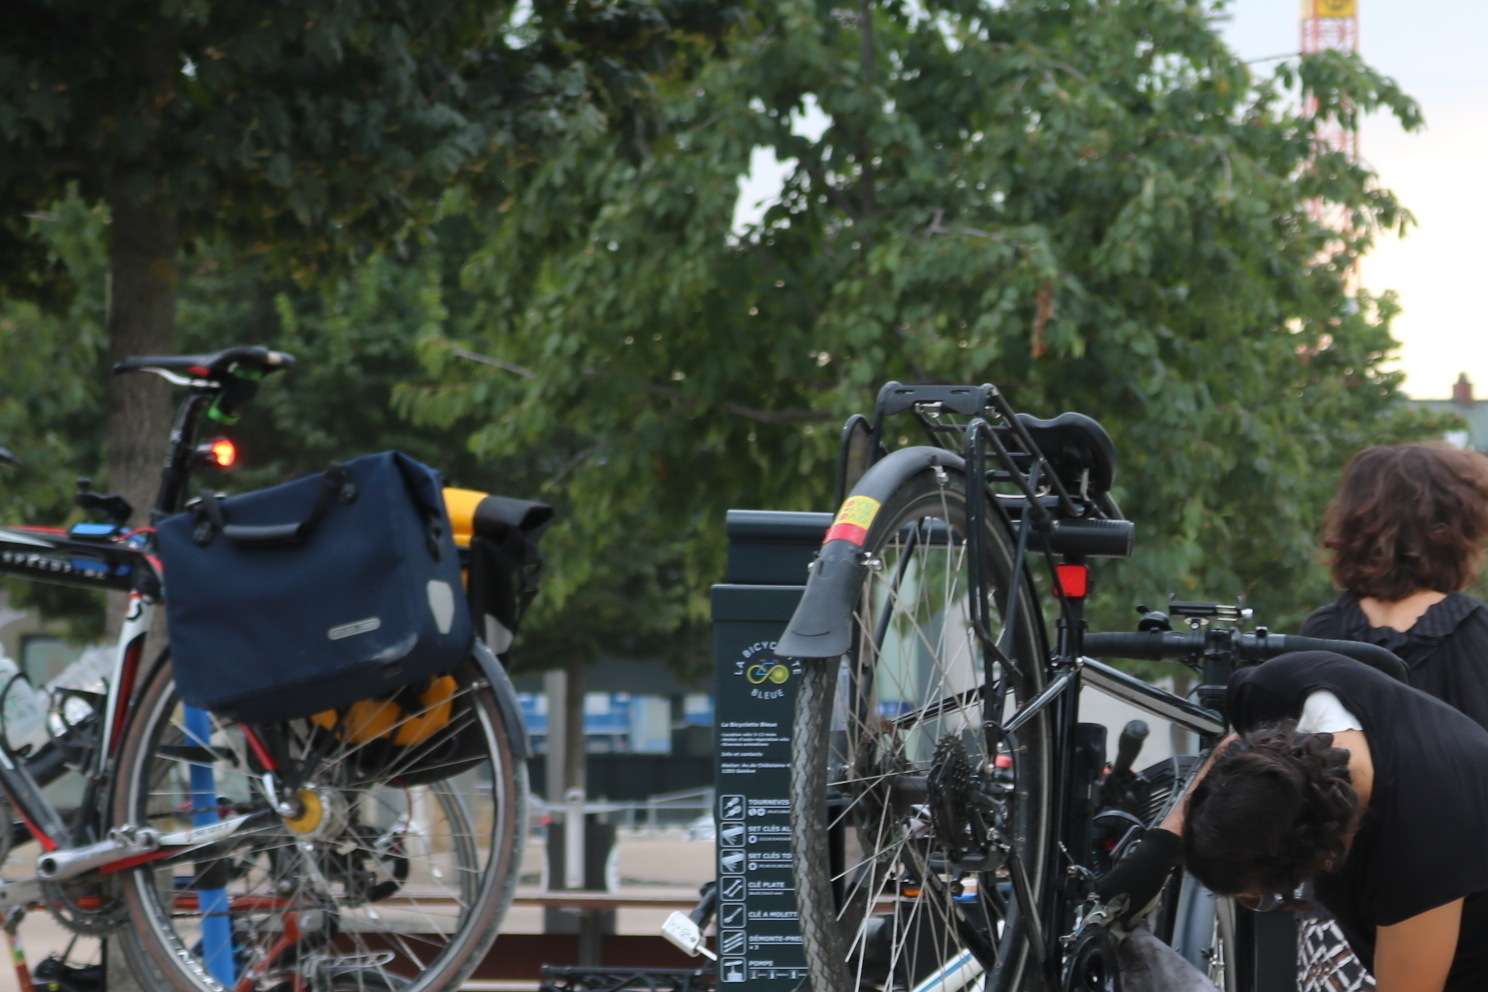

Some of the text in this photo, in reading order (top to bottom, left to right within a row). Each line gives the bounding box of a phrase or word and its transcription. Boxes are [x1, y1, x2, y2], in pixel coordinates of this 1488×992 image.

[734, 661, 746, 676] LA
[751, 688, 785, 700] BLEUE
[762, 824, 781, 832] CLÉS
[762, 851, 781, 859] CLÉS
[748, 910, 762, 918] CLÉ
